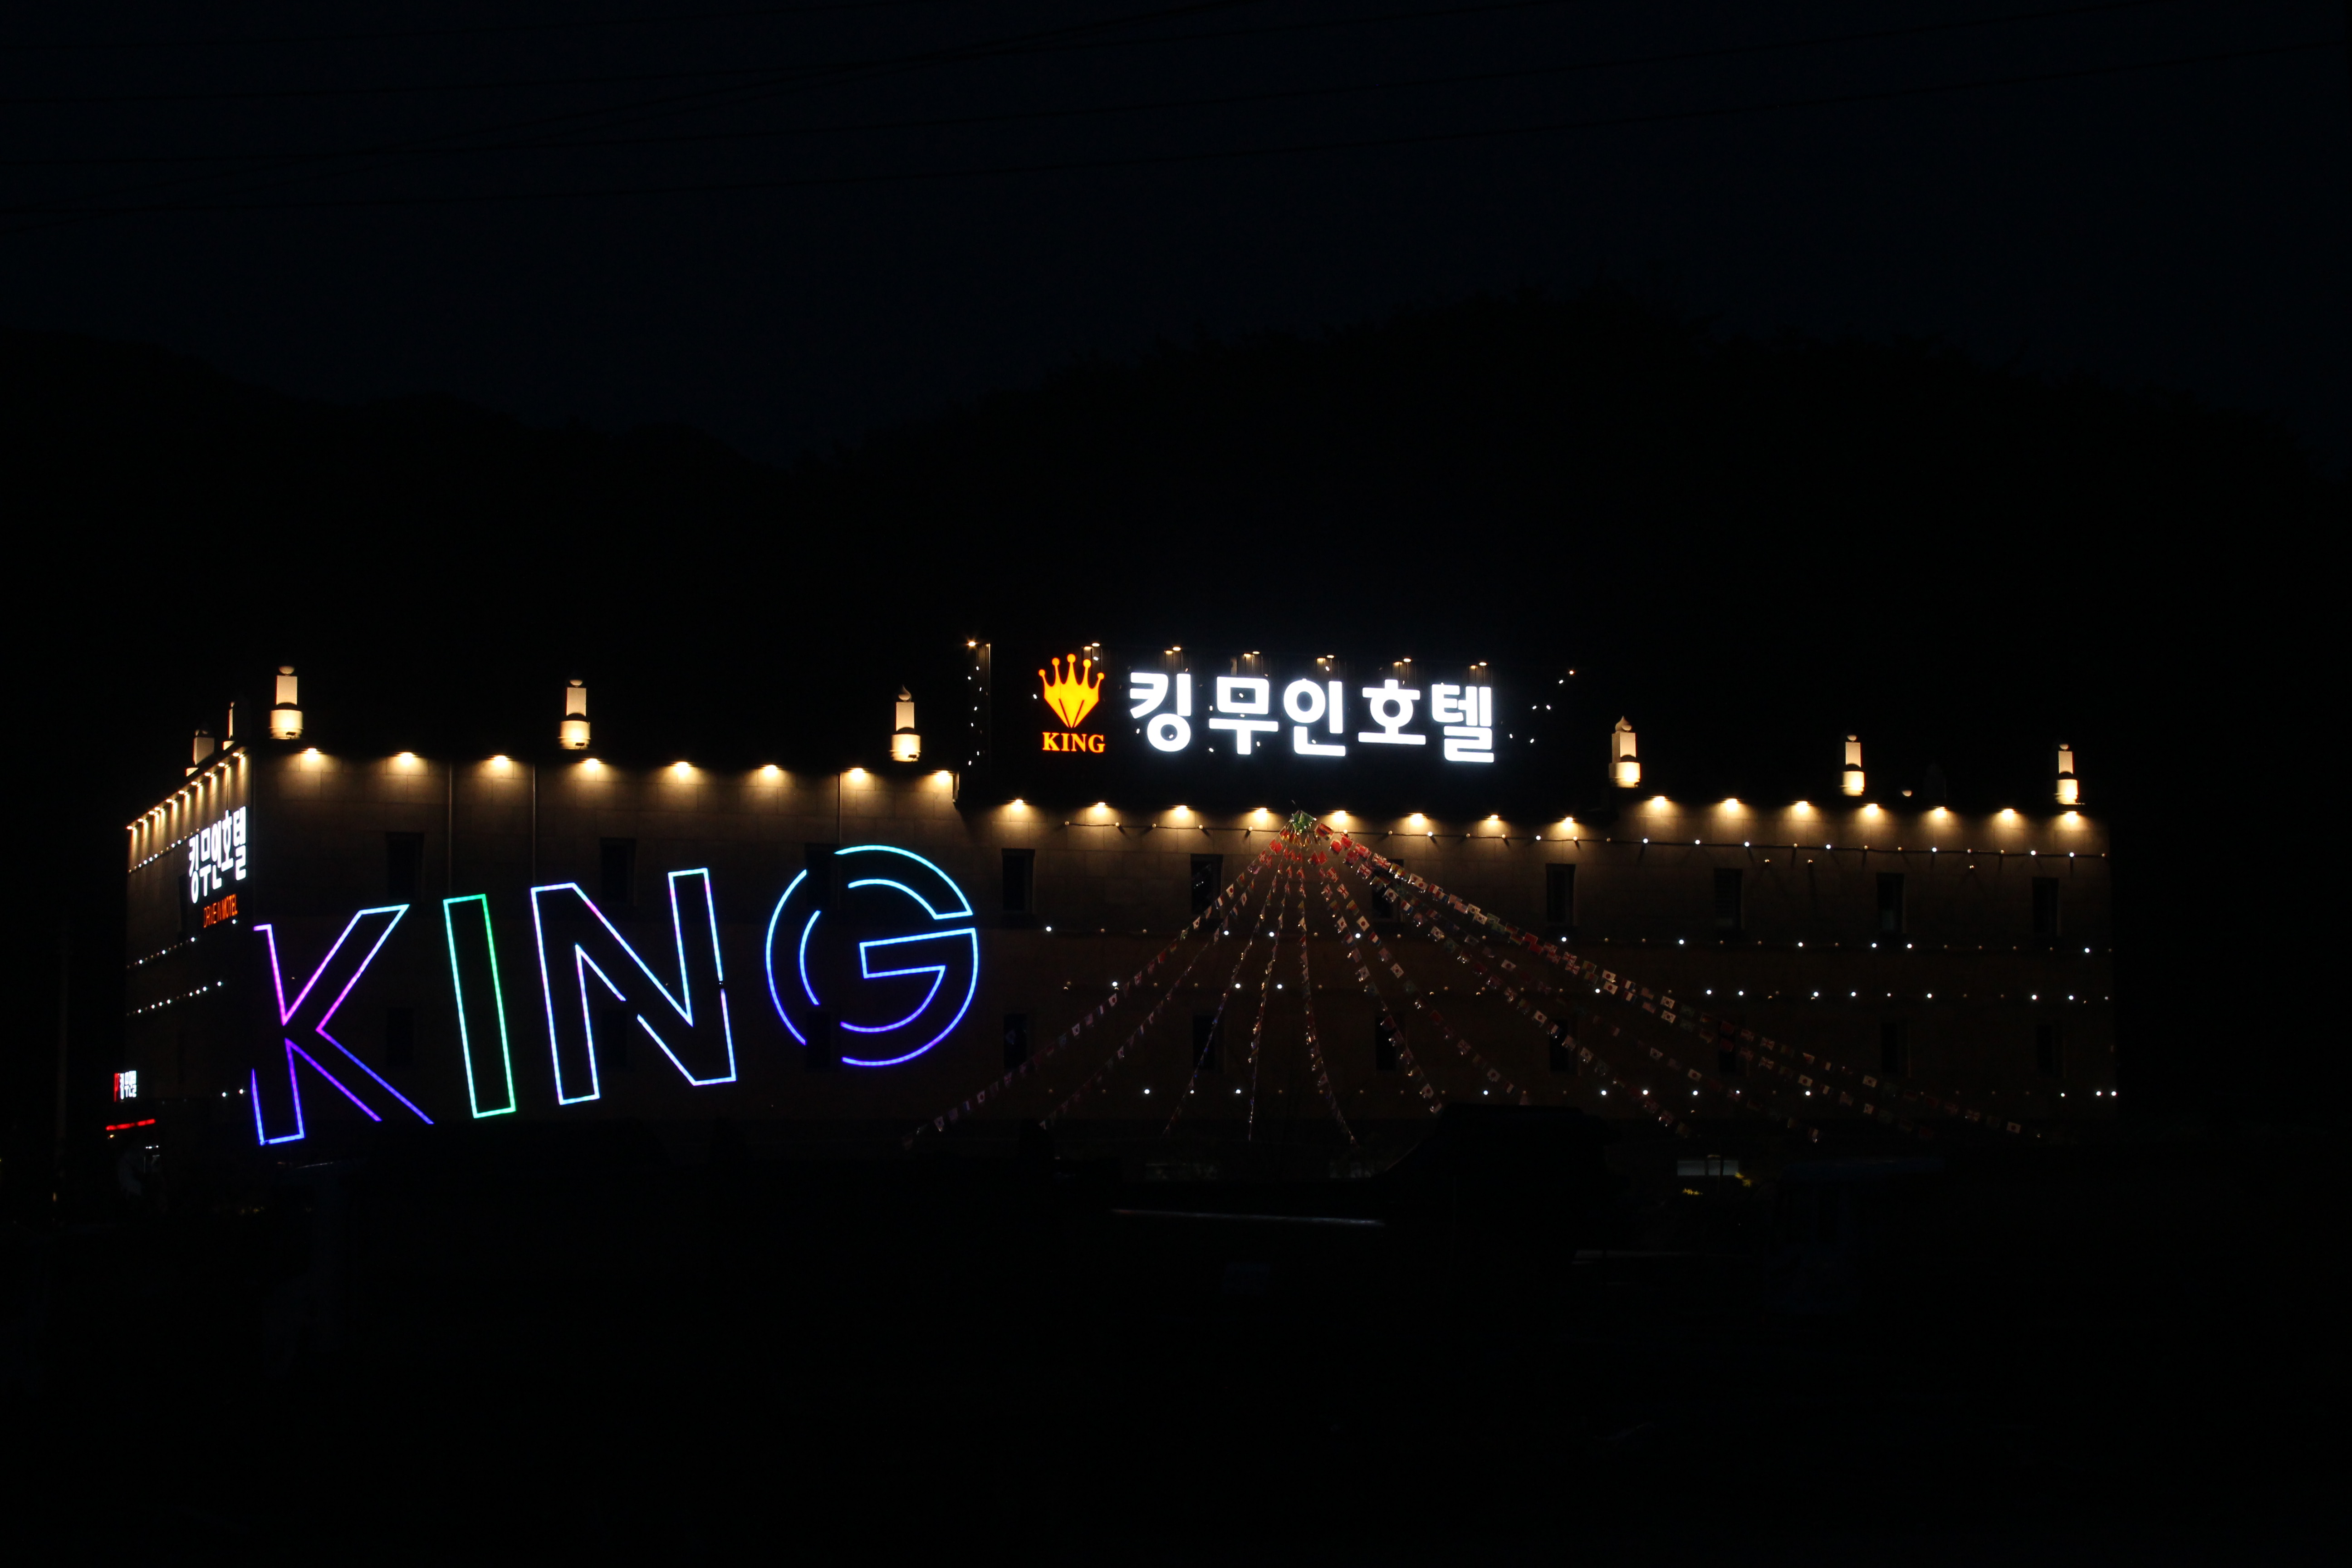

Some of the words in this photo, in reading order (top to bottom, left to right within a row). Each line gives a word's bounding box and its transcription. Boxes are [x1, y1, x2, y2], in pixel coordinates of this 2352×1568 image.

[1042, 731, 1106, 753] KING
[1129, 672, 1495, 763] 킹무인호텔
[189, 806, 246, 903] 킹무인호텔
[252, 845, 979, 1145] KING
